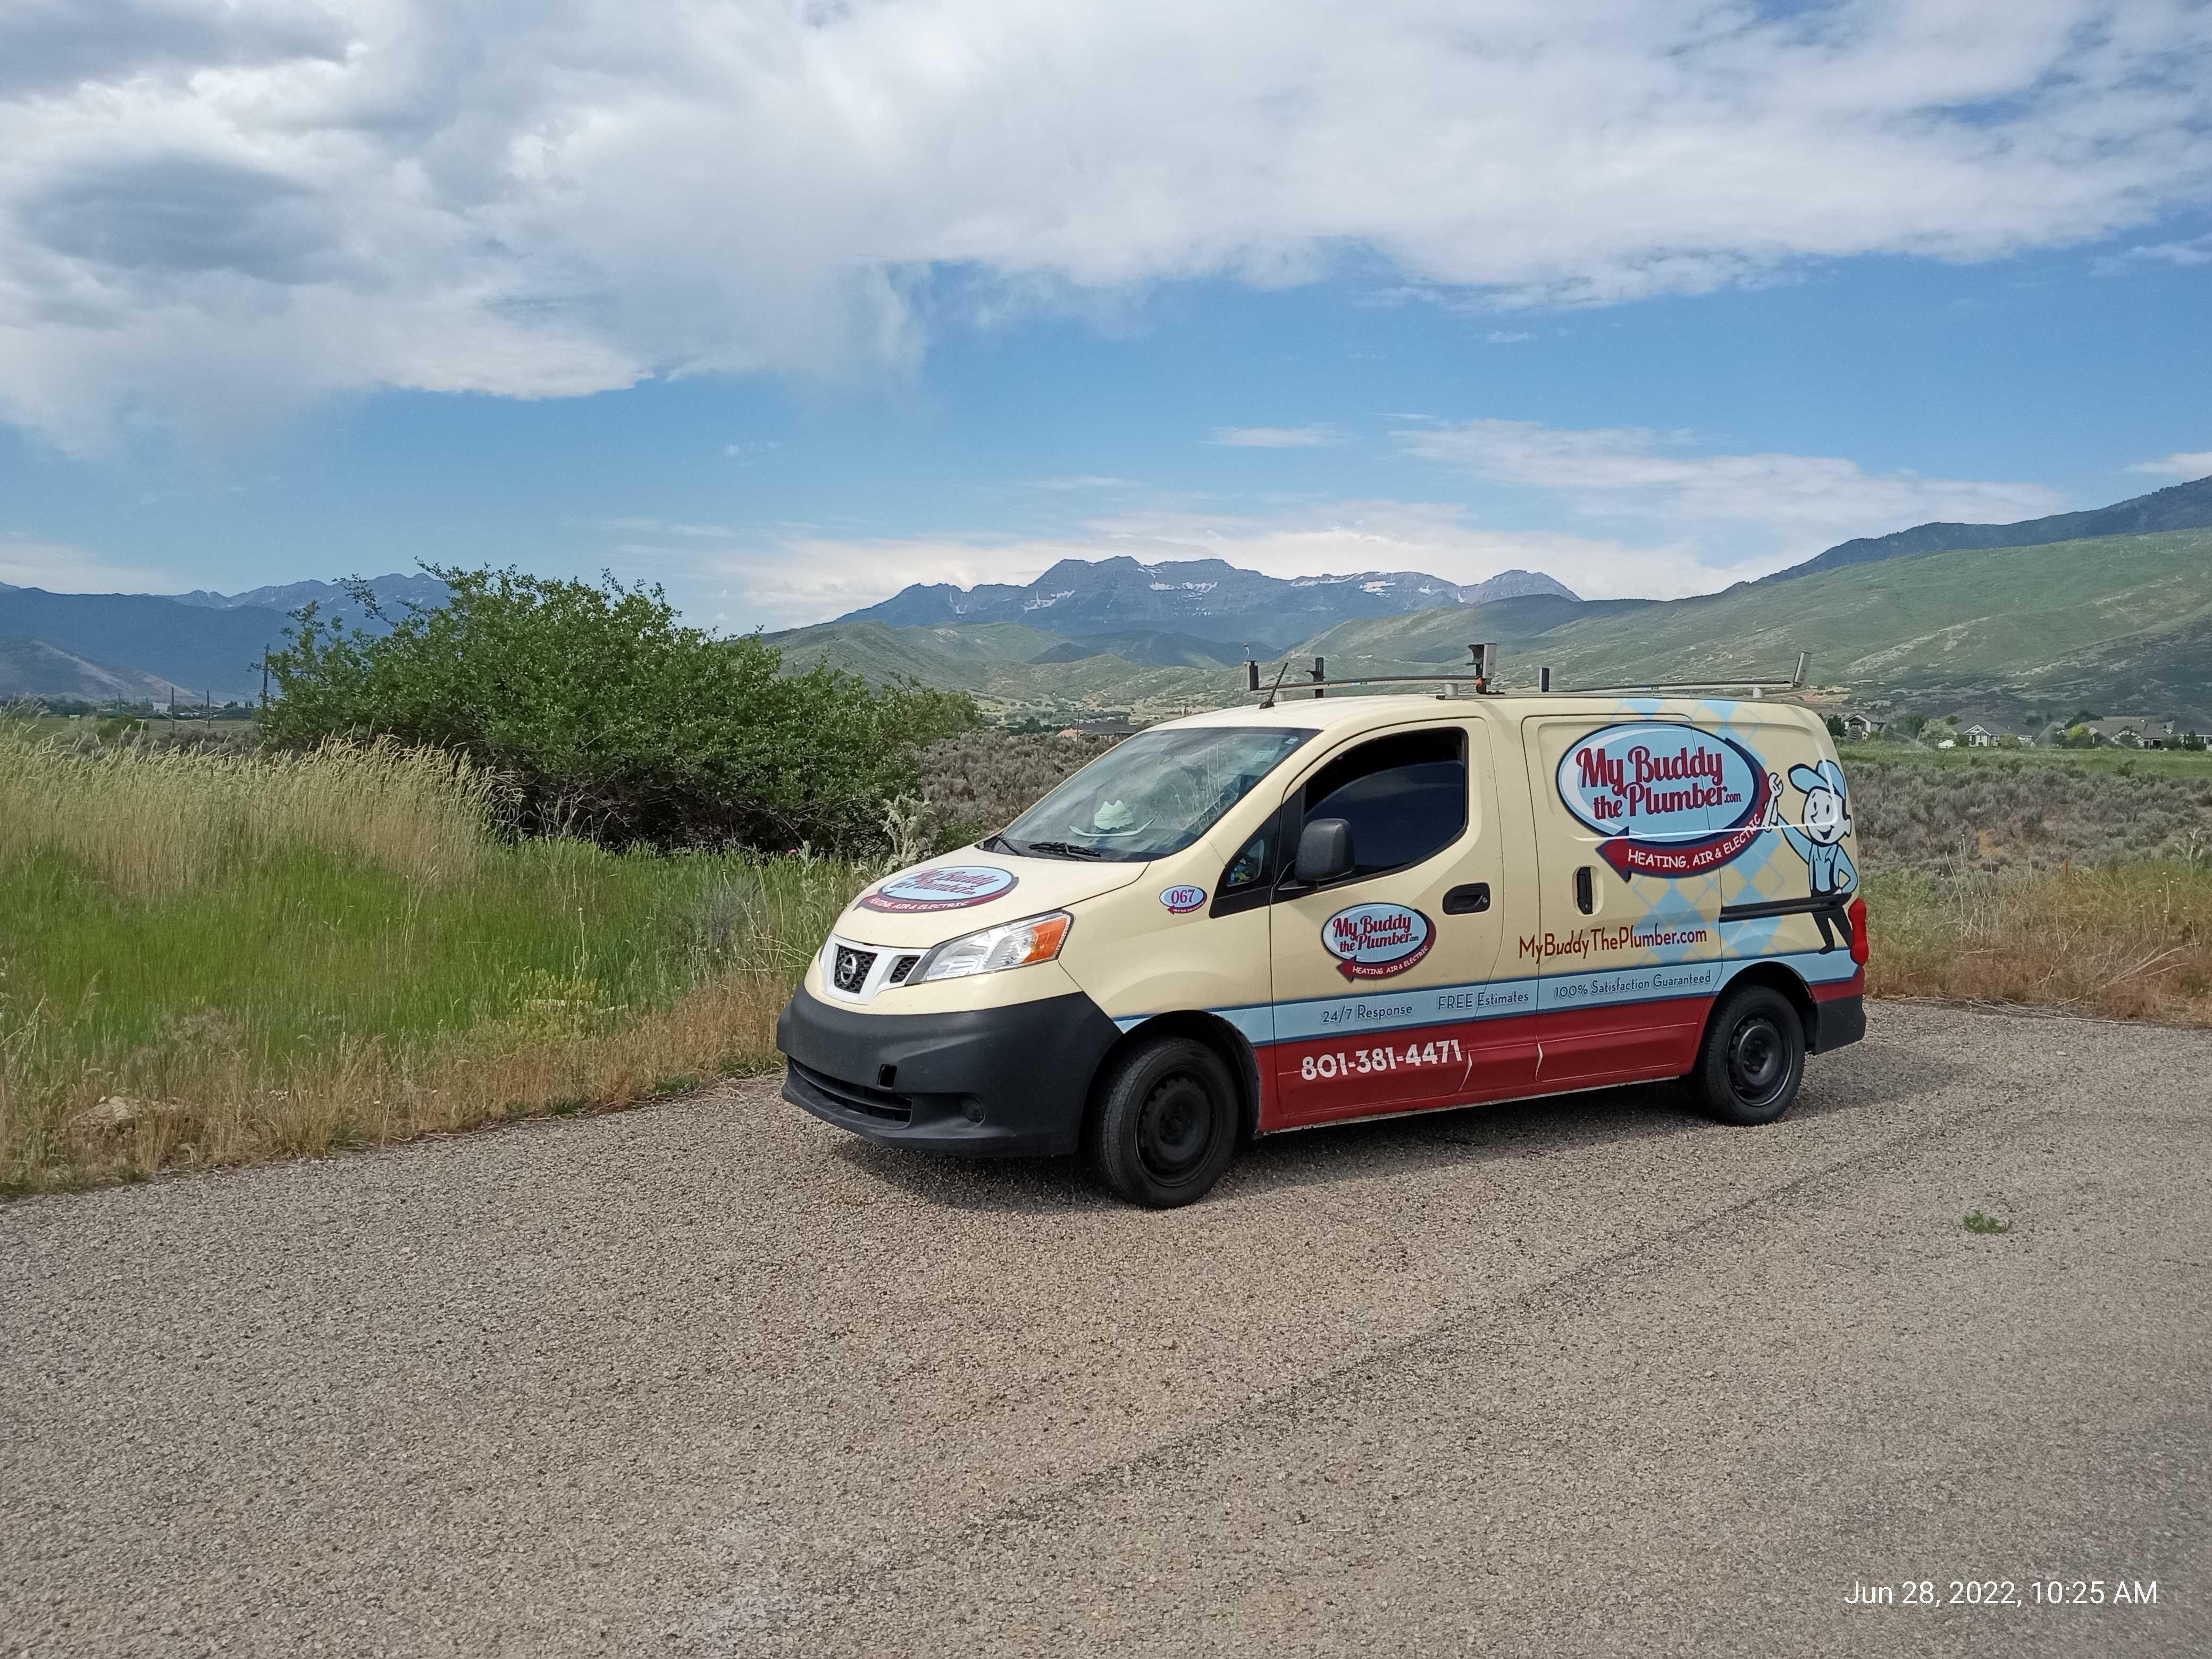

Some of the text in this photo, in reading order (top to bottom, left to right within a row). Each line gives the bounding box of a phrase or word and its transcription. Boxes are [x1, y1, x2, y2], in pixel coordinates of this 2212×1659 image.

[1576, 745, 1723, 796] My Buddy
[1594, 795, 1623, 820] the
[1628, 814, 1761, 869] HEATING, AIR & ELECTRIC
[917, 901, 969, 910] ELECTRIC
[1171, 889, 1195, 904] 067
[1333, 914, 1411, 941] My Buddy
[1339, 941, 1355, 953] the
[1386, 965, 1398, 974] AIR
[1404, 945, 1428, 967] ELECTRIC
[1322, 969, 1711, 1024] 24/7 Response FREE Estimates 100% Satisfaction Guaranteed
[1301, 1039, 1463, 1081] 801-381-4471
